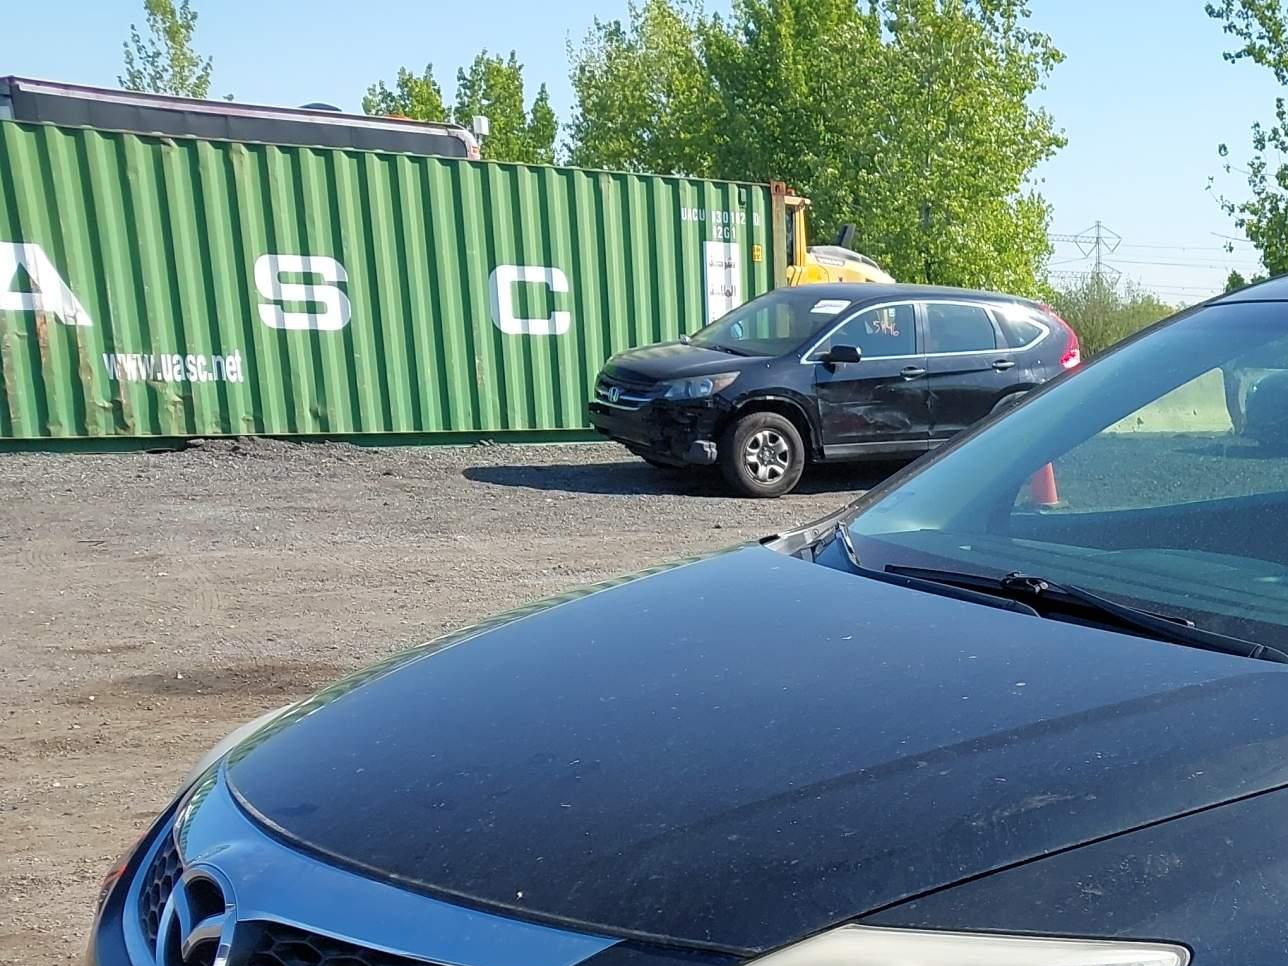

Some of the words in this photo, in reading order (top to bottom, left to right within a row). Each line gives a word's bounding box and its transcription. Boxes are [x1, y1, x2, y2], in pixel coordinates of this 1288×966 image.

[681, 207, 705, 222] UACU
[0, 241, 94, 327] A
[254, 253, 352, 331] S
[487, 264, 571, 336] C
[103, 348, 244, 383] www.uasc.net
